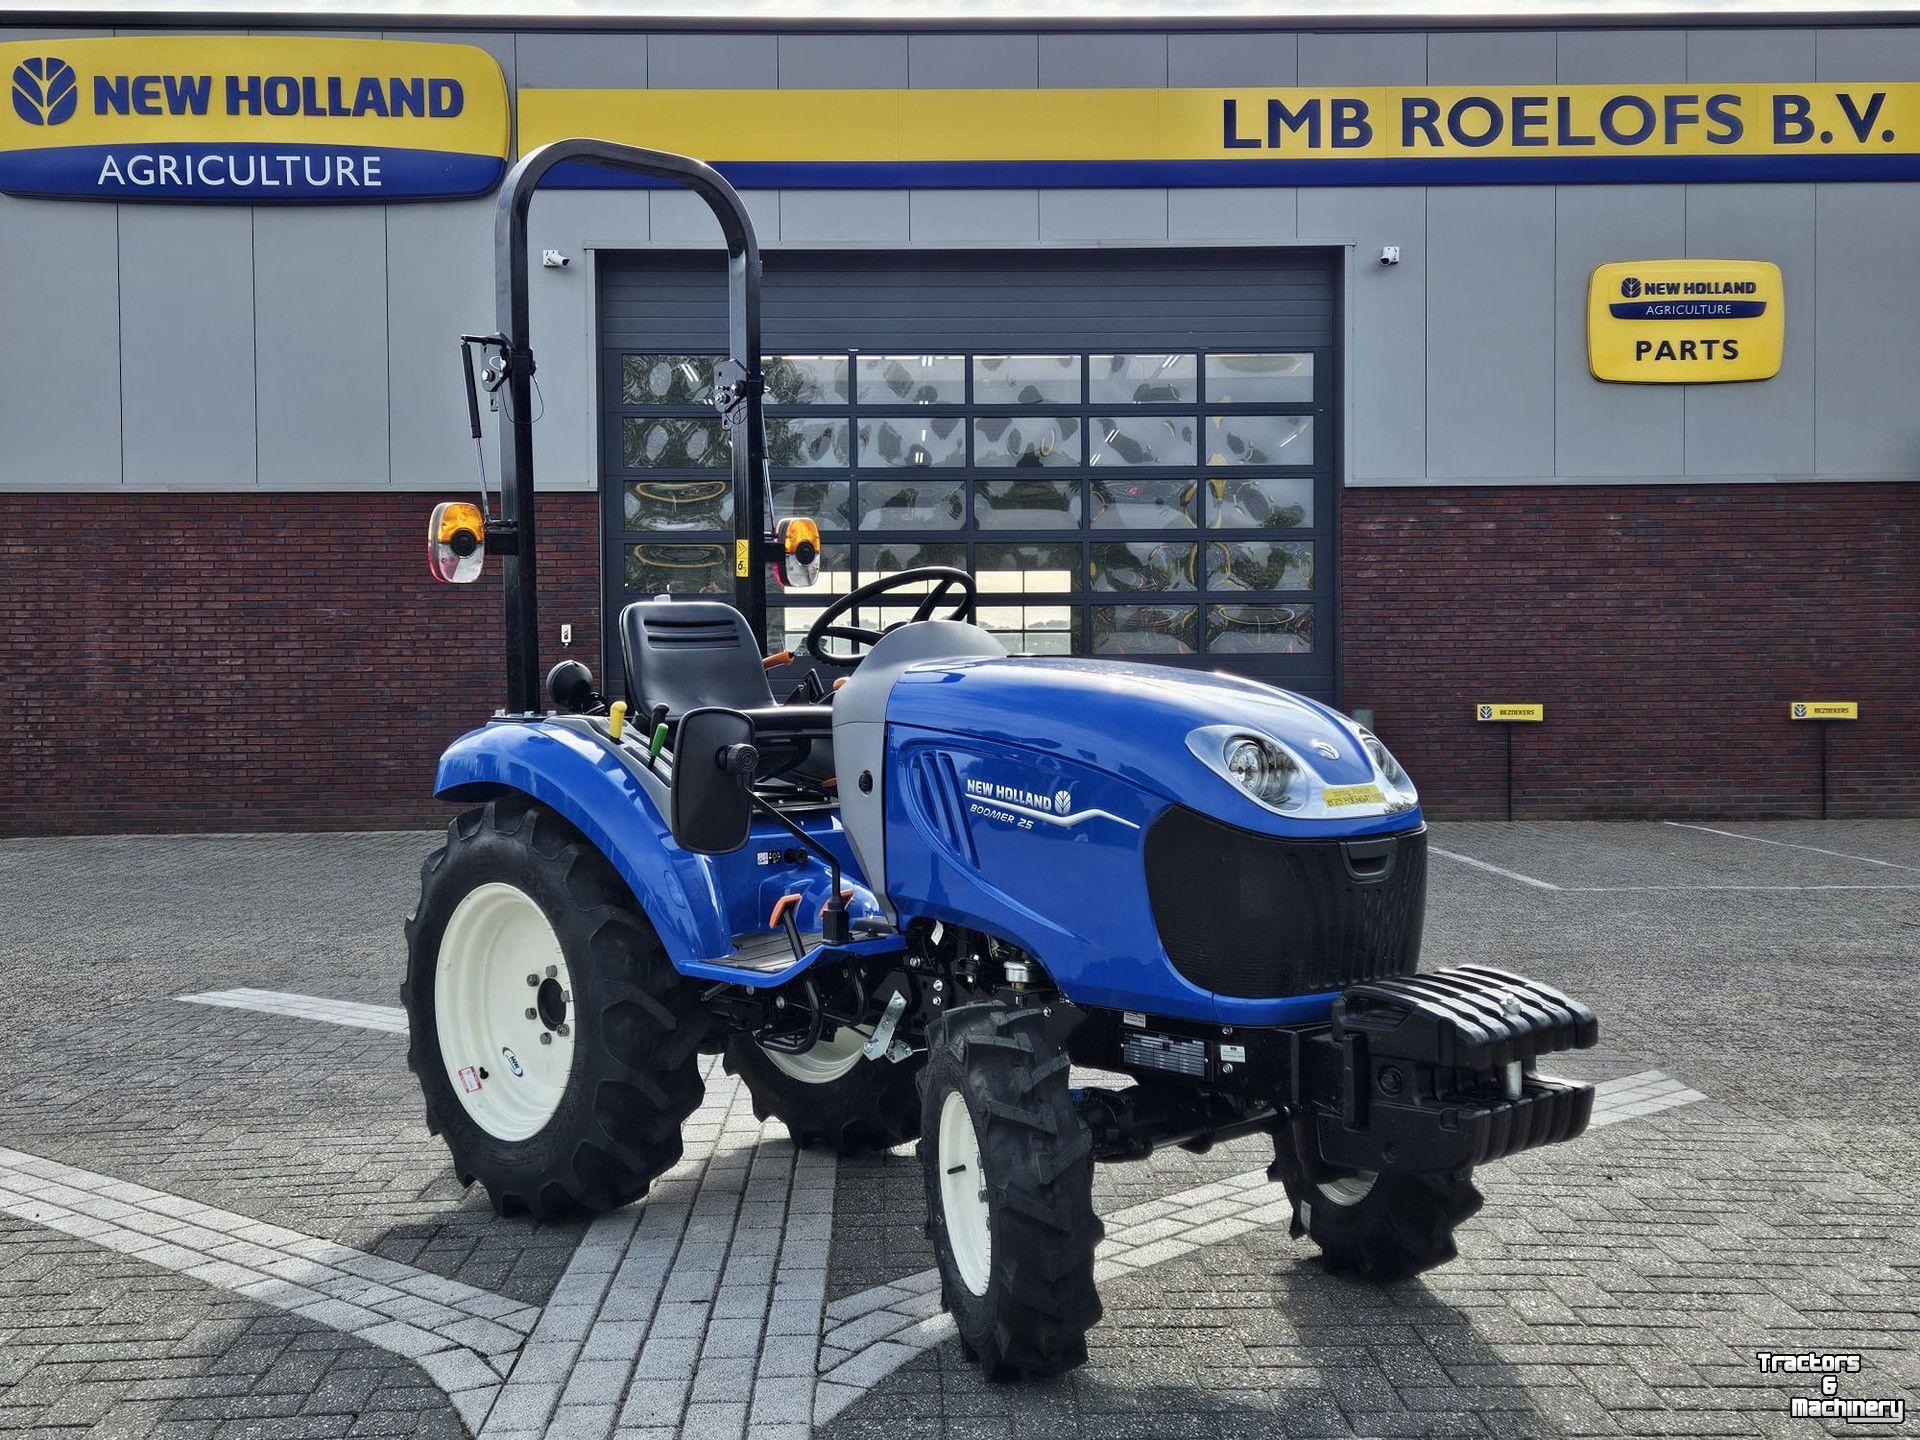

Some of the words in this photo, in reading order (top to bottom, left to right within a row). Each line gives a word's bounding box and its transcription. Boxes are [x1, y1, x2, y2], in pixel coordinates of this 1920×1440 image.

[93, 74, 212, 115] NEW
[226, 75, 465, 118] HOLLAND
[1222, 98, 1373, 150] LMB
[1401, 94, 1745, 148] ROELOFS
[1773, 92, 1897, 145] B.V.
[97, 154, 383, 187] AGRICULTURE
[1644, 282, 1681, 296] NEW
[1684, 281, 1757, 295] HOLLAND
[1645, 304, 1732, 316] AGRICULTURE
[1636, 339, 1739, 362] PARTS
[967, 779, 993, 796] NEW
[996, 785, 1052, 810] HOLLAND
[970, 804, 1015, 823] BOOMER
[1017, 818, 1034, 829] 25
